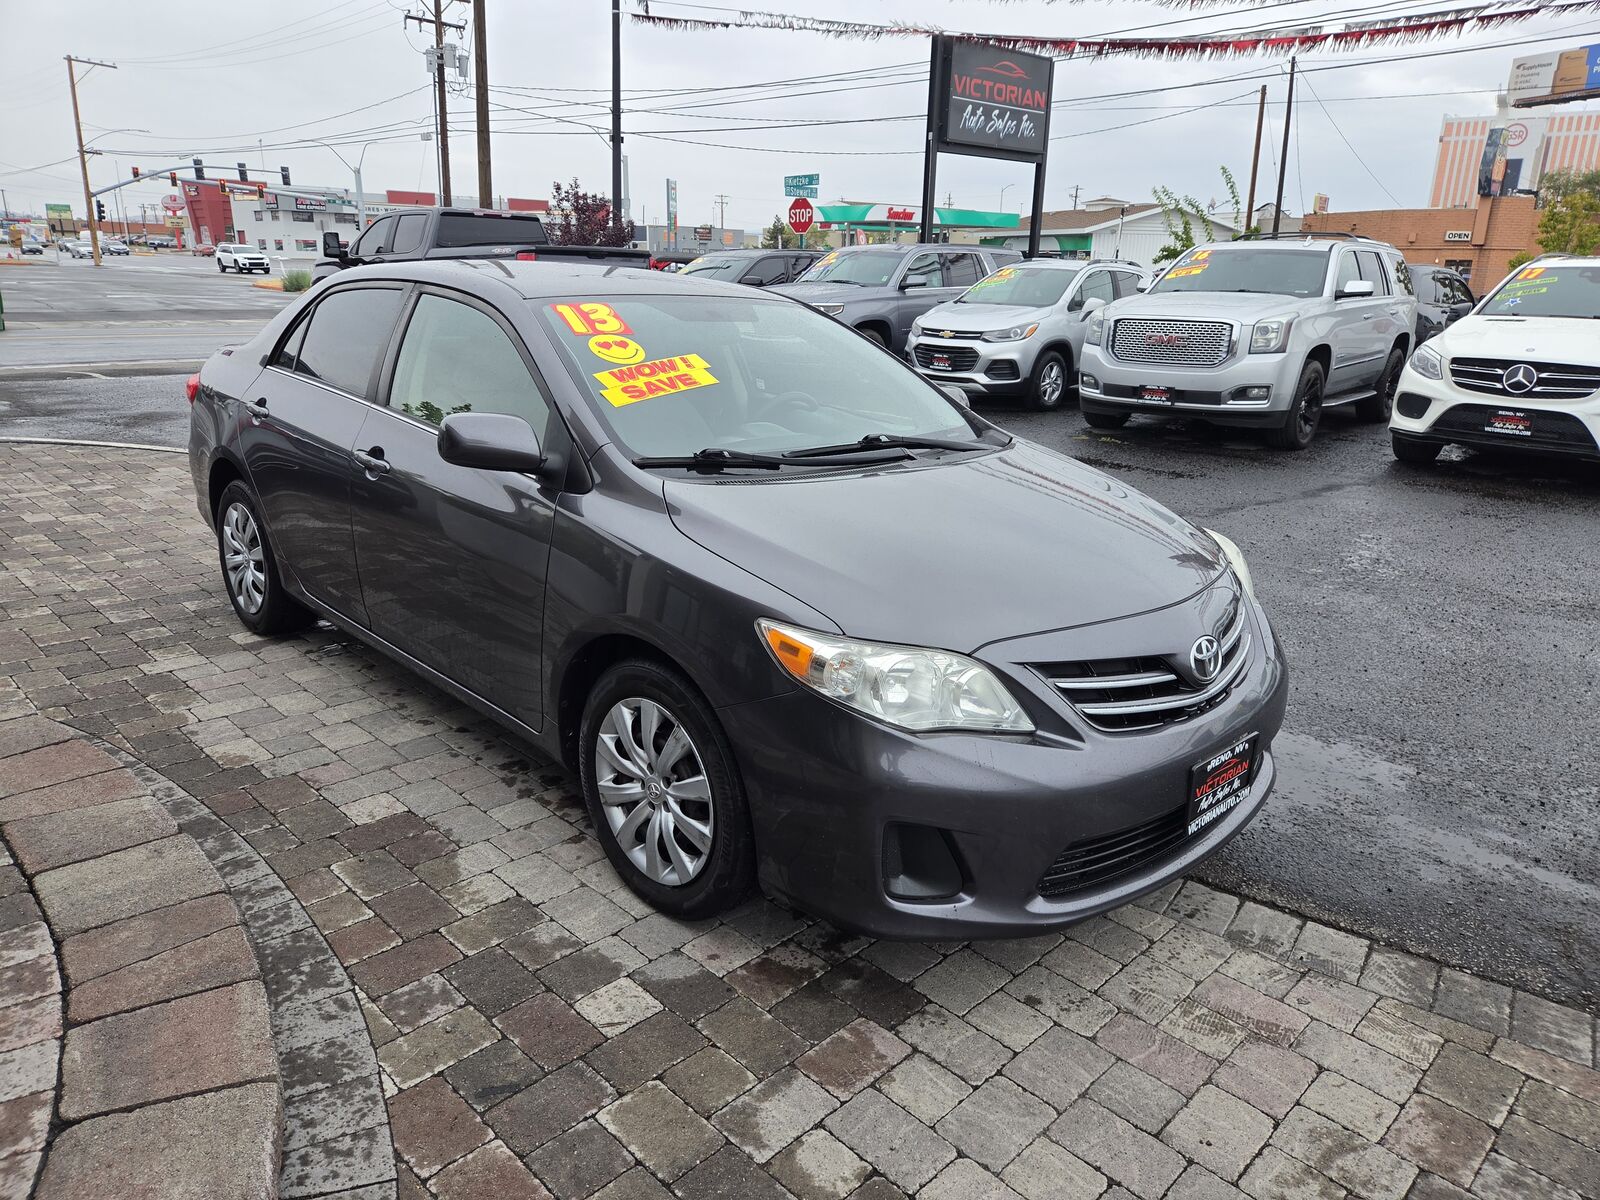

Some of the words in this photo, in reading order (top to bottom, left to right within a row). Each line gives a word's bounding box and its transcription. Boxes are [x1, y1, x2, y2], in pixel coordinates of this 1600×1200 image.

[1521, 62, 1553, 71] SupplyHouse
[954, 74, 1046, 109] VICTORIAN
[960, 104, 985, 133] Auto
[986, 109, 1017, 139] Sales
[789, 176, 809, 186] Kietzke
[790, 186, 811, 197] Stewart
[790, 209, 812, 223] STOP
[1517, 268, 1546, 279] 17
[556, 303, 625, 334] 13
[1145, 333, 1189, 347] GMC
[620, 373, 702, 400] SAVE
[1490, 417, 1530, 426] VICTORIAN
[1210, 751, 1233, 770] RENO,
[1196, 760, 1249, 798] VICTORIAN
[1188, 786, 1251, 836] VICTORIANAUTO.COM
